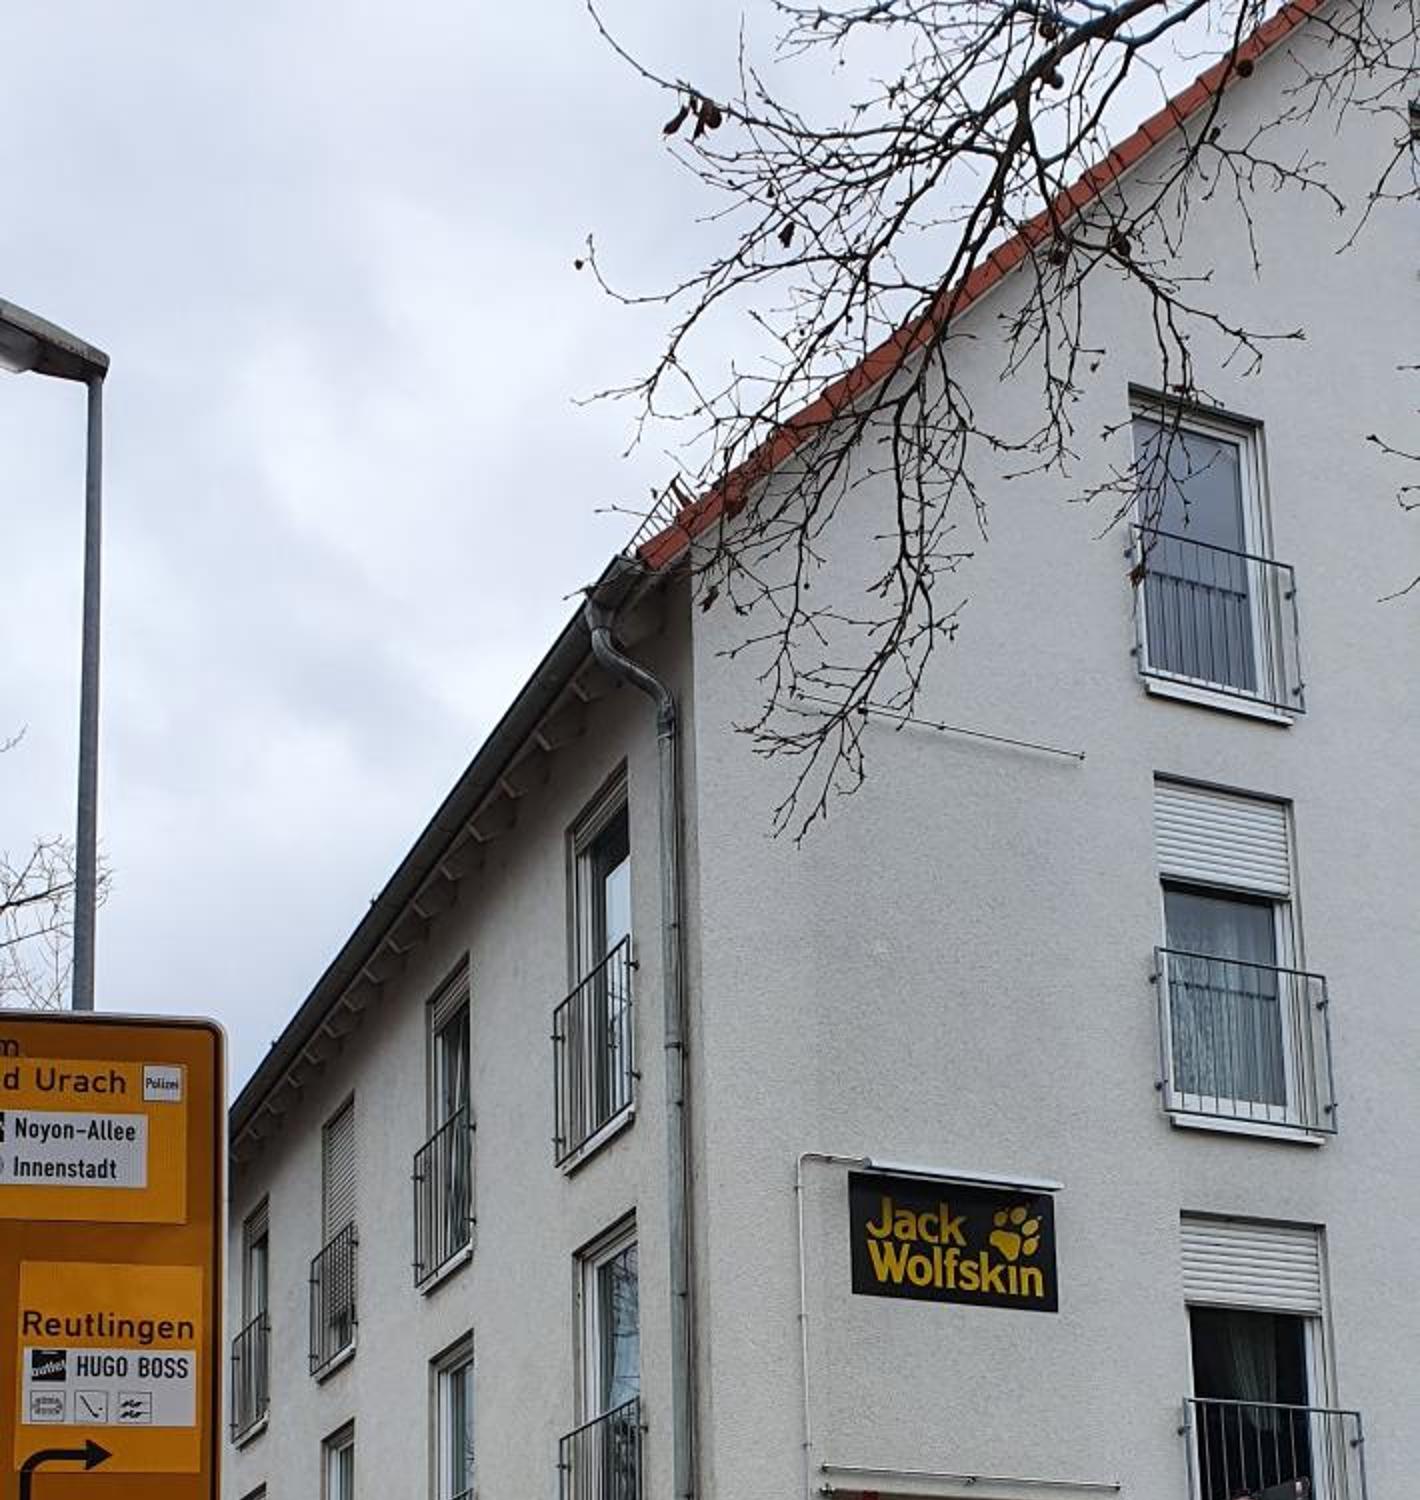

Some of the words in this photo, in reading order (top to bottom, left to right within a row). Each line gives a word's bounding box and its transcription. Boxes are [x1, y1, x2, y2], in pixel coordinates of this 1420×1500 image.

[0, 1039, 19, 1057] m
[3, 1066, 19, 1090] d
[36, 1066, 126, 1094] Urach
[145, 1076, 179, 1089] Polizei
[15, 1117, 136, 1144] Noyon-Allee
[13, 1156, 117, 1180] Innenstadt
[865, 1196, 966, 1247] Jack
[867, 1239, 1045, 1298] Wolfskin
[22, 1310, 194, 1345] Reutlingen
[76, 1355, 128, 1378] HUGO
[138, 1357, 189, 1379] BOSS
